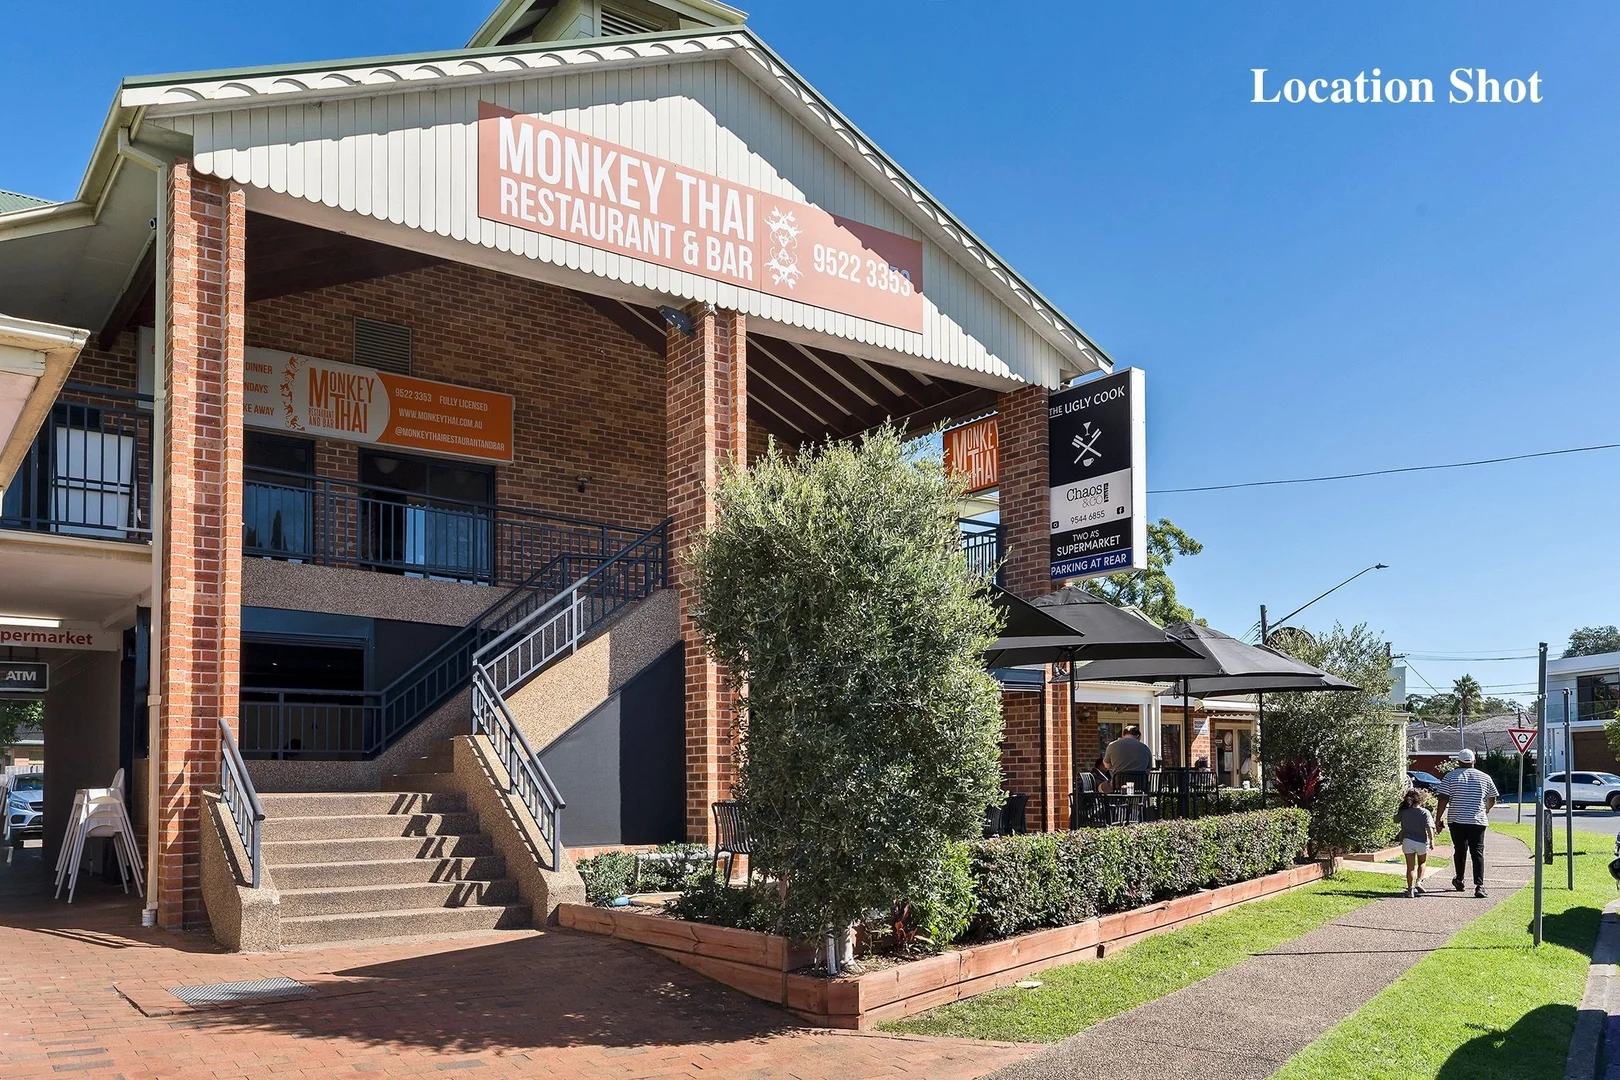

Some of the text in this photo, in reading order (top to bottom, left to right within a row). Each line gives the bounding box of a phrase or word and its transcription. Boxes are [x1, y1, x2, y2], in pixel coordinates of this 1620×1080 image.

[499, 117, 754, 243] MONKEY THAI
[500, 176, 753, 281] RESTAURANT & BAR
[813, 243, 911, 297] 9522 3353
[245, 361, 273, 375] DINNER
[309, 367, 375, 409] MONKEY
[254, 404, 275, 416] AWAY
[395, 388, 488, 412] 9522 3353 FULLY LICENSED
[1049, 385, 1125, 416] THE UGLY COOK
[308, 407, 334, 419] RESTAURANT
[309, 416, 335, 429] AND BAR
[330, 393, 368, 434] THAI
[398, 408, 483, 430] WWW.MONKEYTHAI.COM.AU
[395, 426, 505, 452] @MONKEYTHAIRESTAURANTANDBAR
[967, 448, 998, 489] THAI
[1066, 484, 1103, 502] Chaos
[1070, 510, 1106, 525] 9544 6855
[1056, 534, 1121, 557] SUPERMARKET
[1072, 531, 1089, 542] TWO
[1050, 553, 1127, 576] PARKING AT REAR
[5, 670, 37, 681] ATM
